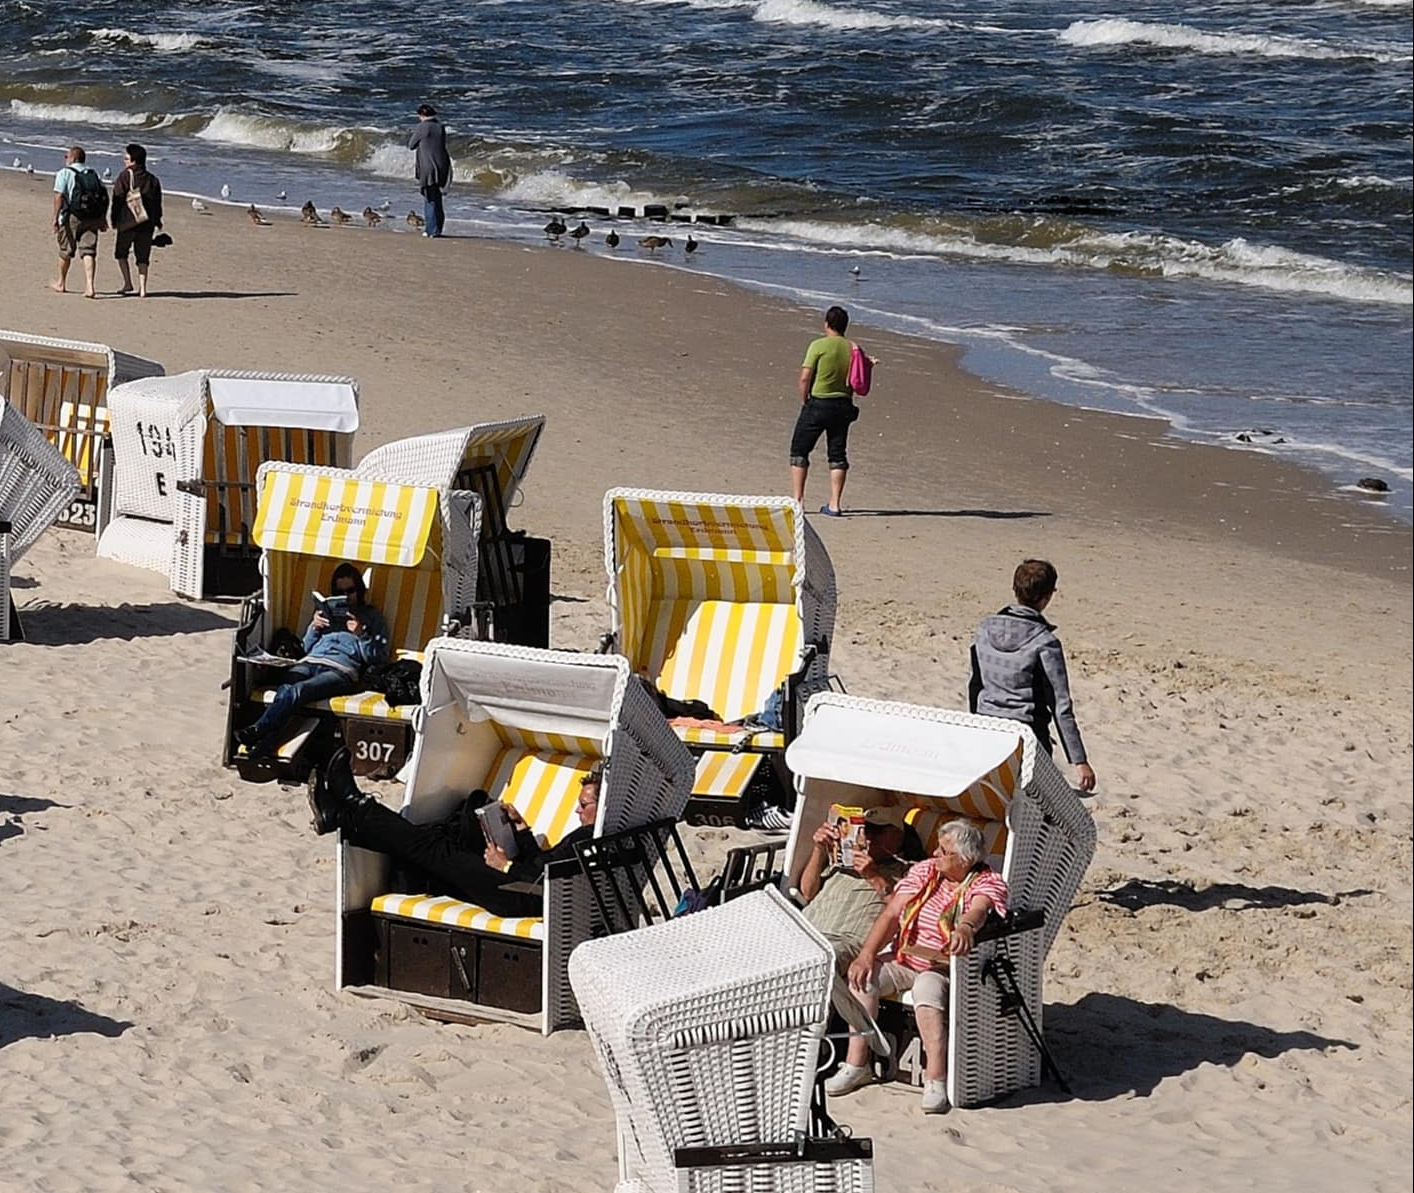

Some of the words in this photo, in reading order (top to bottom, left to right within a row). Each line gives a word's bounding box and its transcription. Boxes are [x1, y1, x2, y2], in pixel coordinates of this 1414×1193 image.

[156, 472, 168, 496] E
[320, 512, 367, 526] Erdmann
[356, 740, 395, 763] 307
